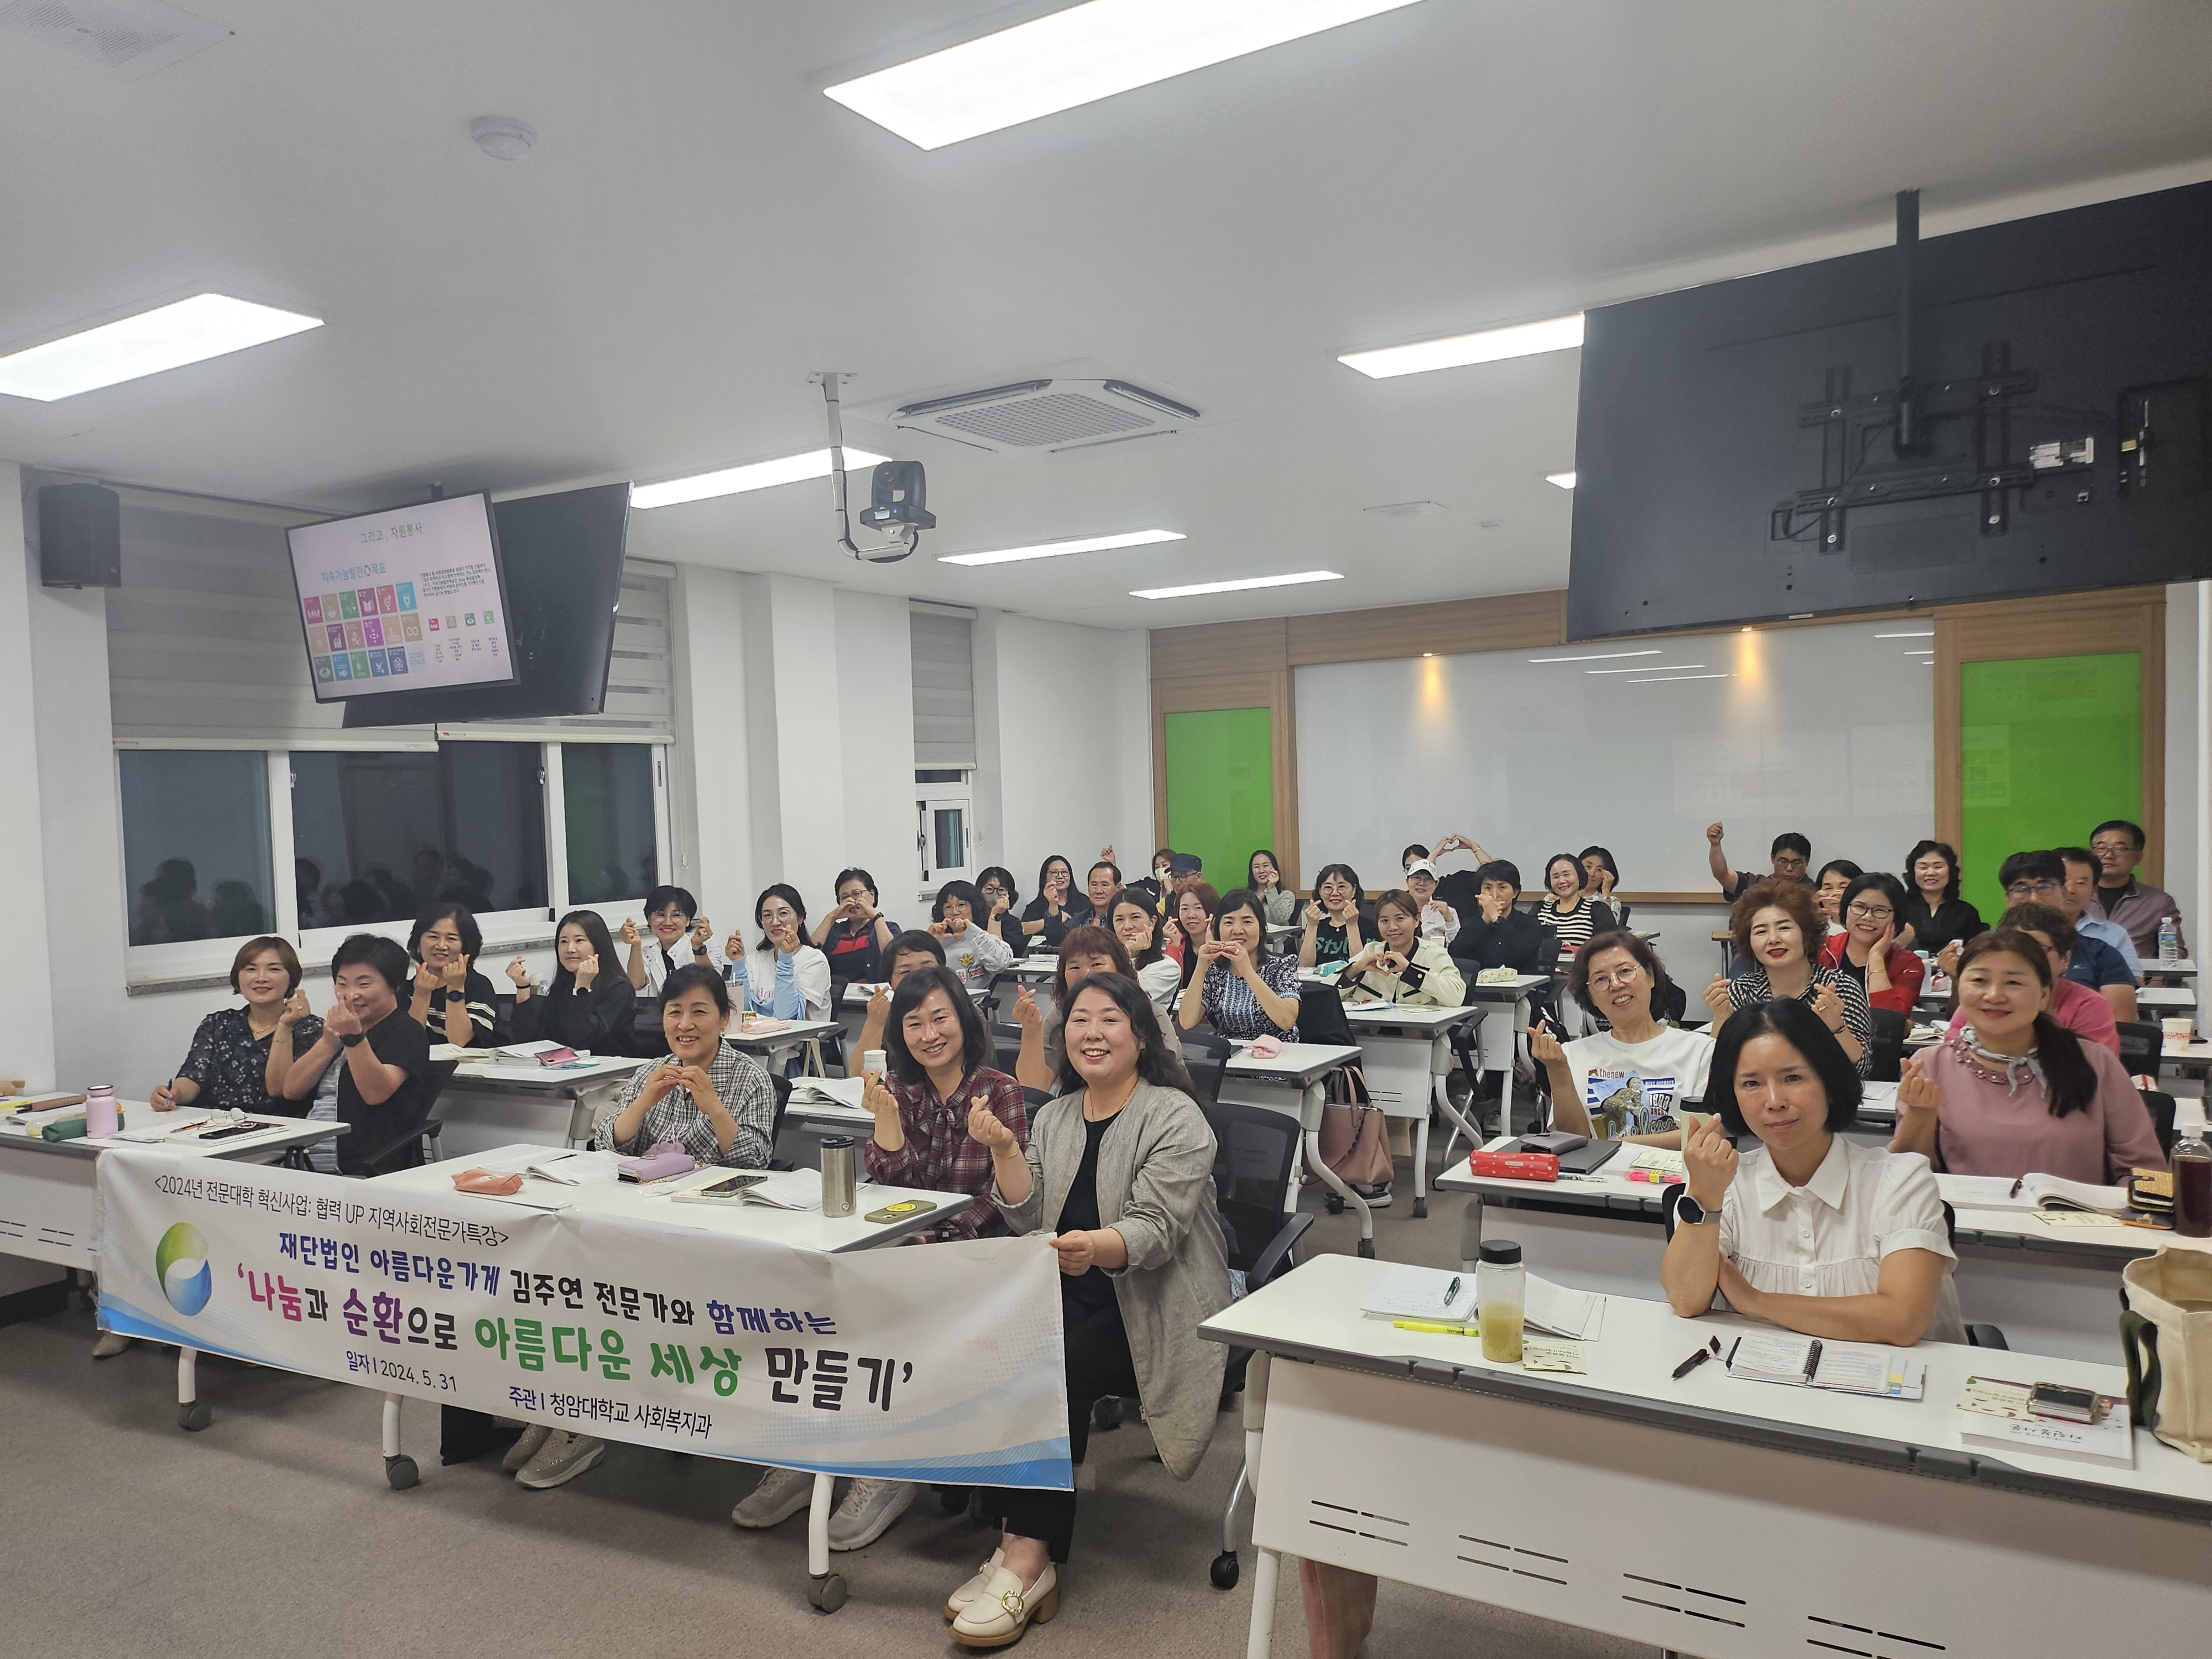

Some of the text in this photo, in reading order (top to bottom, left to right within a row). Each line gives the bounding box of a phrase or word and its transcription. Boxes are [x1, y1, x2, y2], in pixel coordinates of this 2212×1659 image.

[390, 523, 422, 539] 자원봉사
[1316, 936, 1348, 954] Styl
[1600, 1068, 1625, 1079] thenew
[155, 1175, 204, 1199] <2024년
[207, 1181, 254, 1208] 전문대학
[316, 1198, 342, 1221] 협력
[346, 1202, 364, 1223] UP
[279, 1232, 837, 1335] 재단법인 아름다운가게 김주연 전문가와 함께하는
[343, 1287, 458, 1351] 순환으로
[475, 1317, 630, 1381] 아름다운
[651, 1342, 742, 1397] 세상
[346, 1350, 370, 1373] 일자
[440, 1375, 457, 1392] 31
[509, 1386, 537, 1411] 주관
[549, 1392, 630, 1425] 청암대학교
[634, 1405, 712, 1439] 사회복지과
